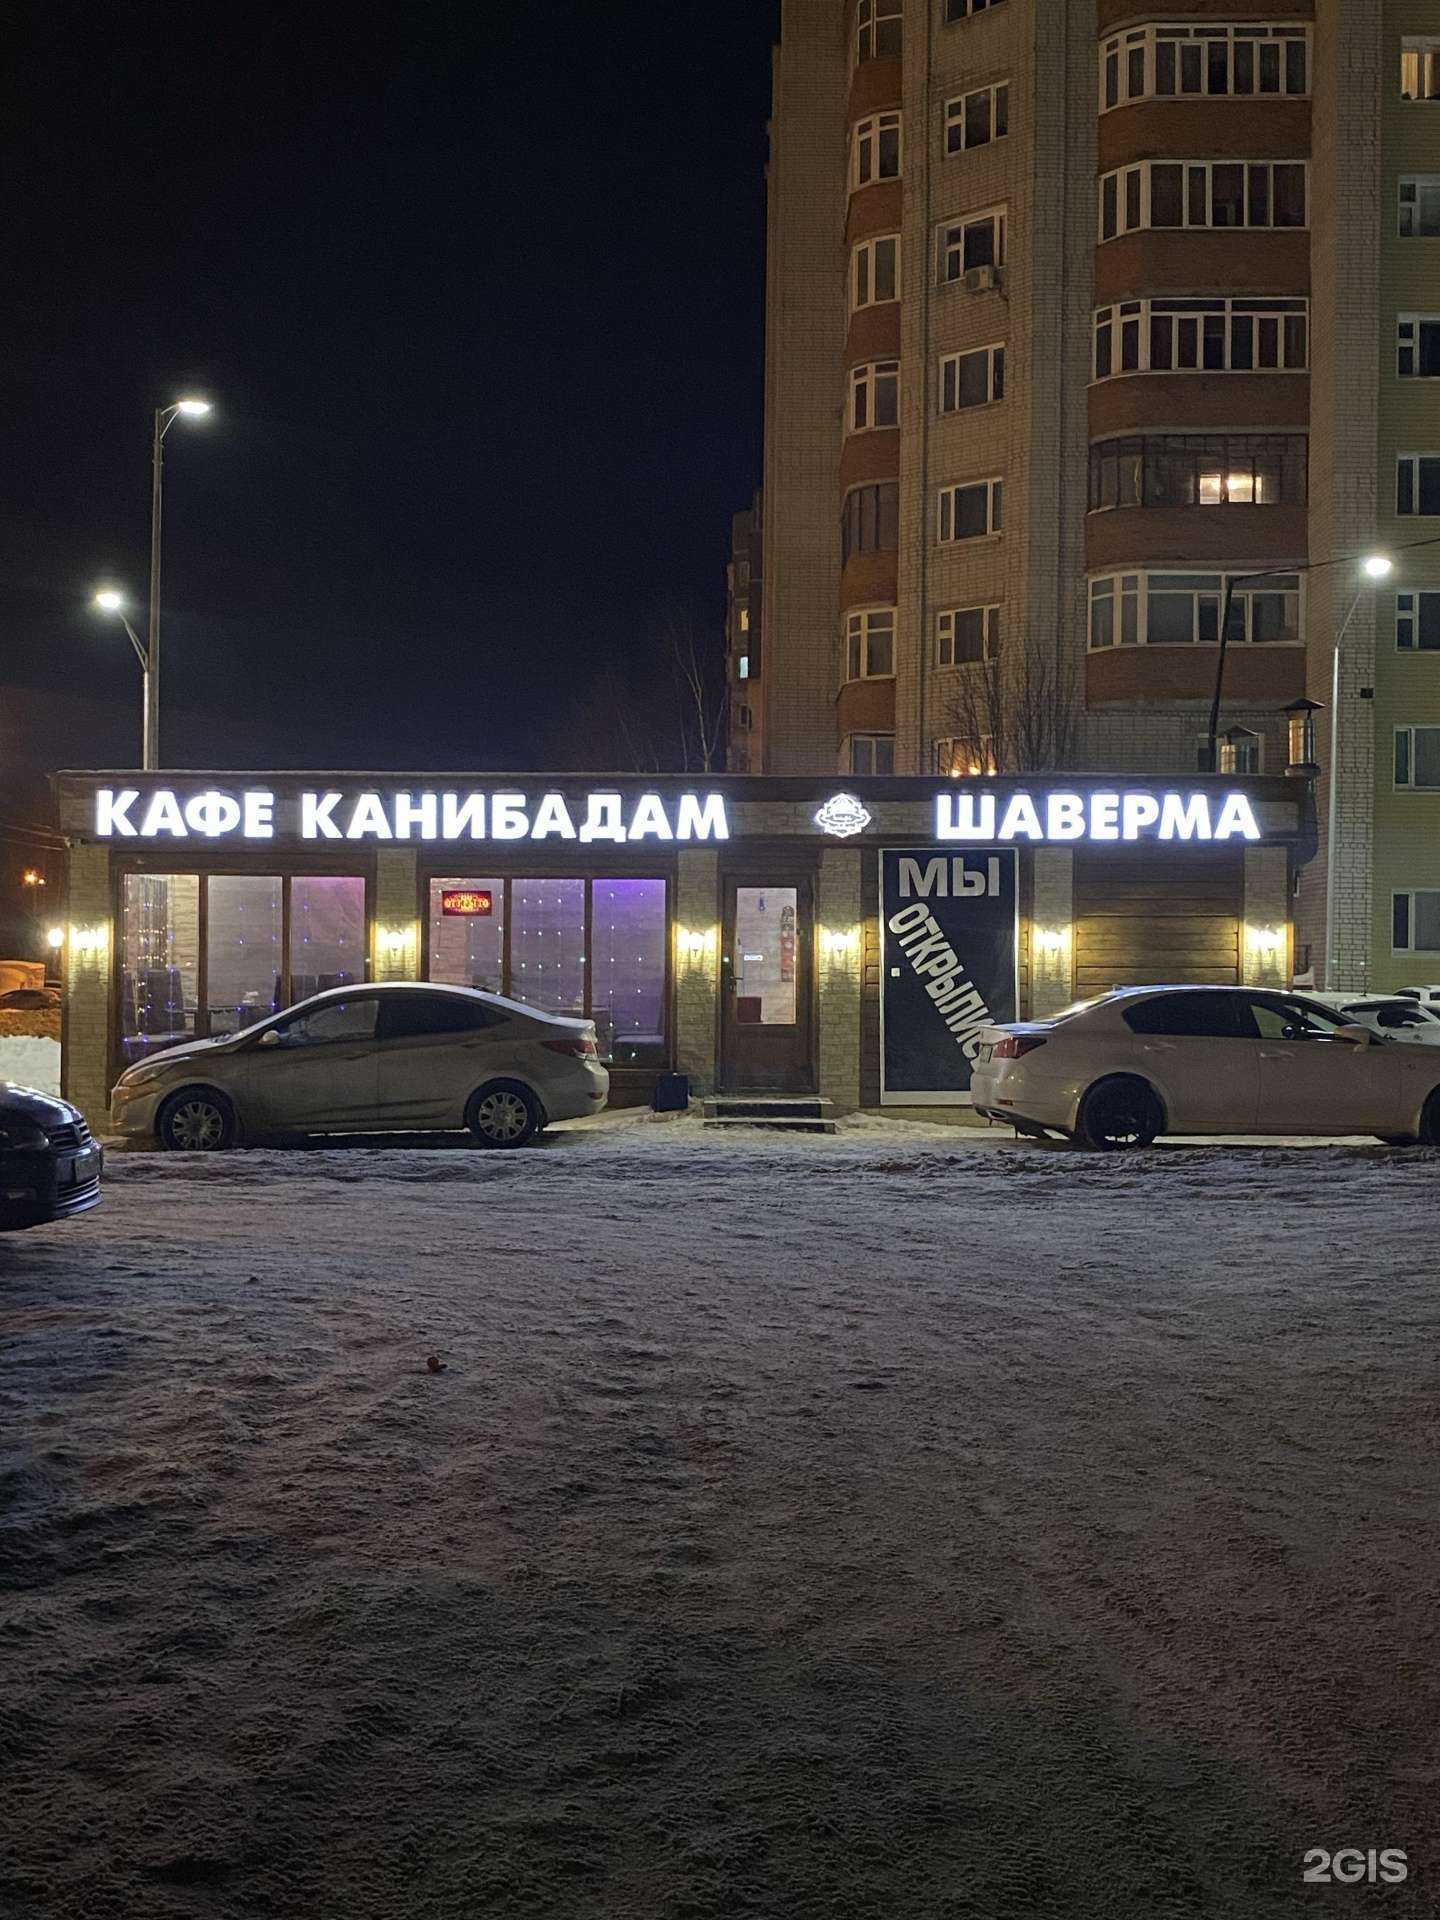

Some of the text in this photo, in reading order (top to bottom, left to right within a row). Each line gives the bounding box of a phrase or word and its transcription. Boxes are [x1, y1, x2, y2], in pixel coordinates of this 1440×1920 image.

[96, 789, 730, 843] КАФЕ КАНИБАДАМ
[936, 793, 1262, 840] ШАВЕРМА
[898, 856, 1000, 897] МЫ
[888, 902, 996, 1072] ОТКРЫЛИ
